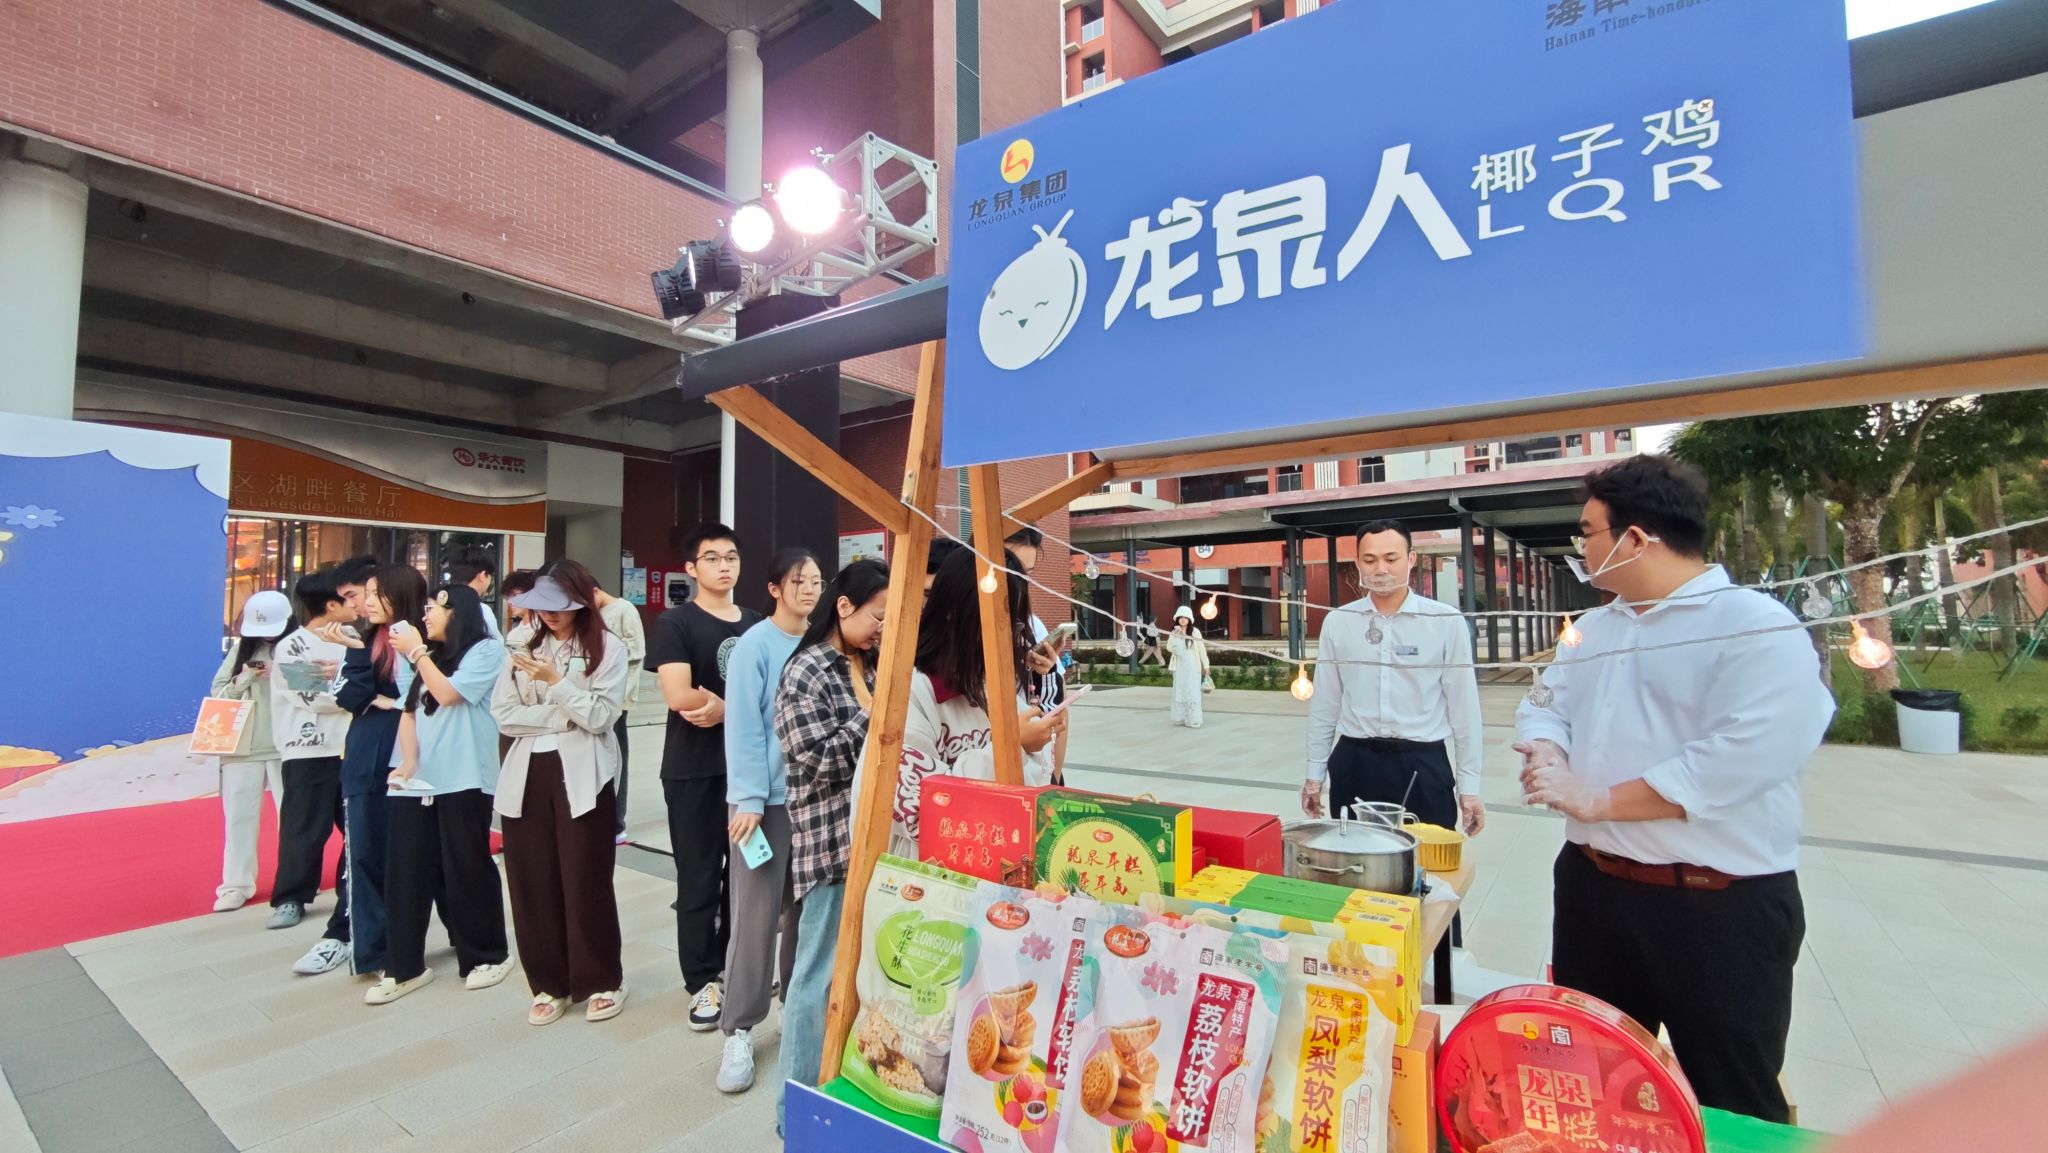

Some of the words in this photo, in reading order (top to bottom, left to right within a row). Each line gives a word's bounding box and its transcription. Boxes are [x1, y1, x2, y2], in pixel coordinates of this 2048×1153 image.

[1544, 27, 1596, 51] Hainan
[1471, 99, 1720, 200] 椰子鸡
[967, 207, 1025, 231] LONGQUAN
[1029, 193, 1067, 212] GROUP
[969, 169, 1068, 221] 龙泉集团
[1104, 143, 1473, 330] 龙泉人
[249, 496, 321, 513] Lakeside
[325, 502, 372, 518] Dining
[1200, 979, 1232, 1001] 龙泉
[1229, 987, 1249, 1037] 海南特产
[1310, 989, 1344, 1011] 龙泉
[1348, 997, 1363, 1046] 海南特产
[1176, 1002, 1226, 1138] 荔枝软饼
[1300, 1015, 1340, 1152] 凤梨软饼
[1522, 1069, 1589, 1104] 龙泉
[1526, 1099, 1610, 1152] 年糕
